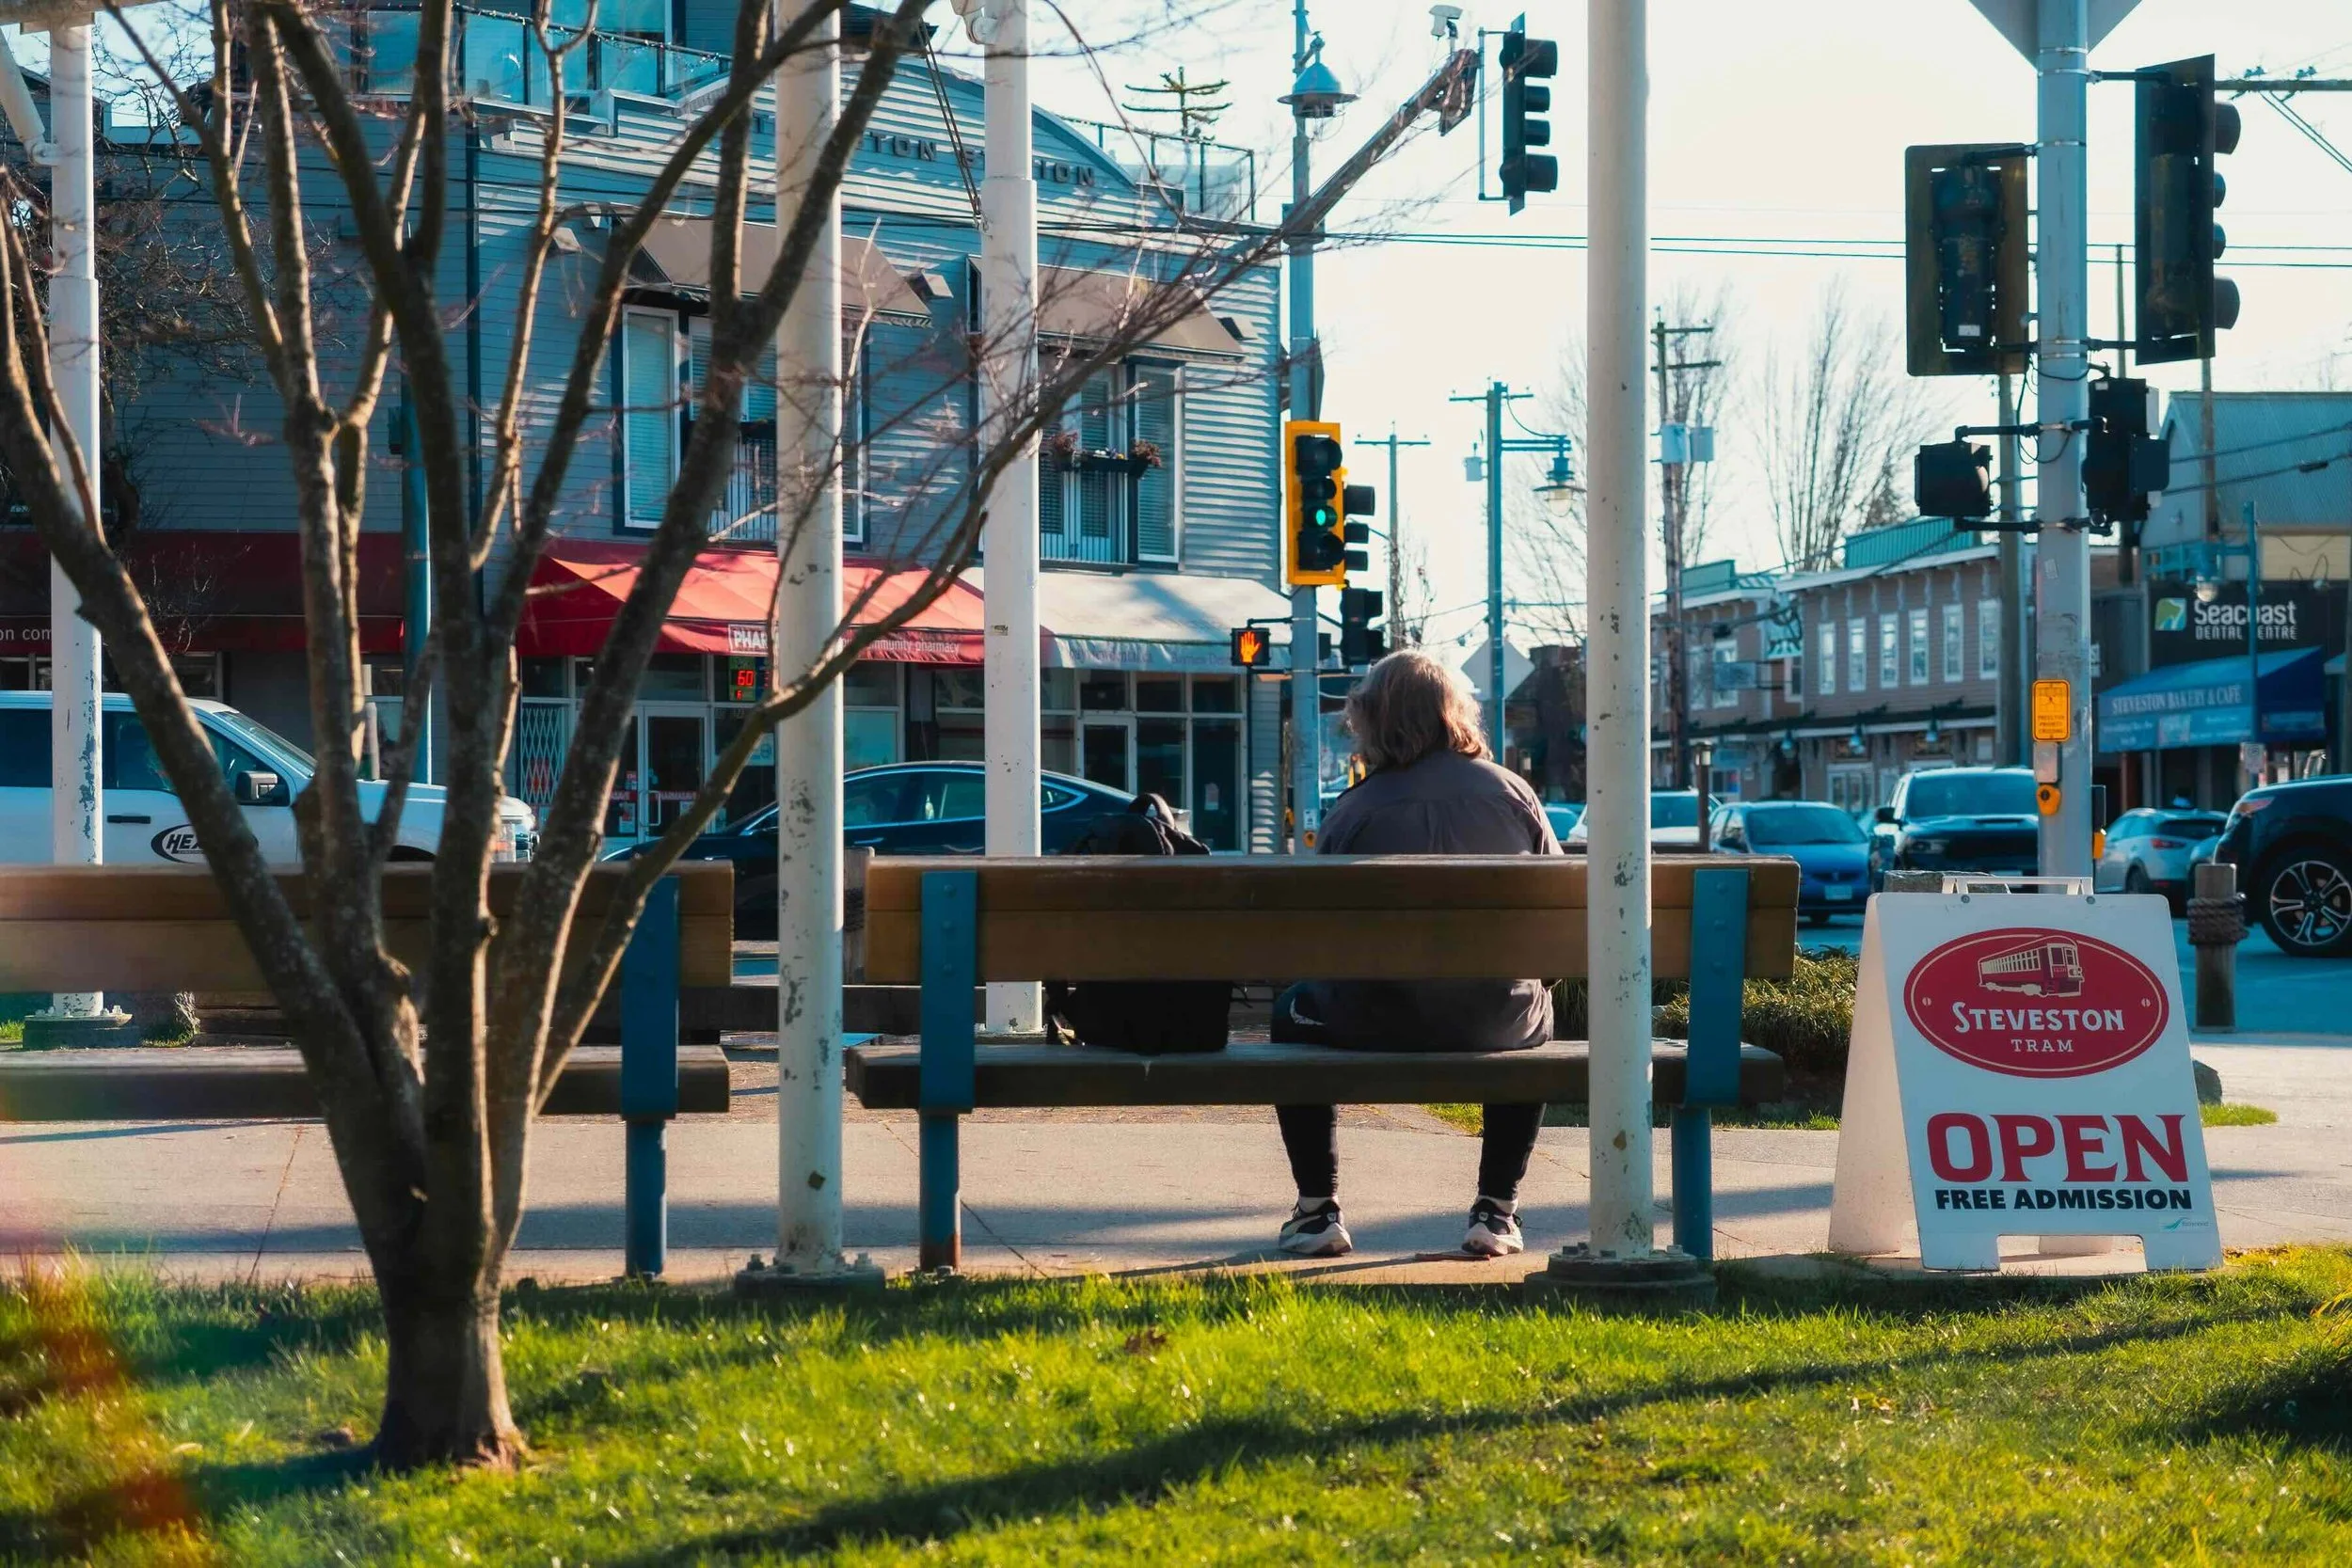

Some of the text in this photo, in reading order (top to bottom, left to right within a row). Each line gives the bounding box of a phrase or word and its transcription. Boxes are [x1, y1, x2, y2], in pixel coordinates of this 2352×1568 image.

[2195, 625, 2297, 640] DENTAL ENTRE
[867, 639, 911, 653] mmunity
[737, 670, 755, 687] 60
[1952, 1001, 2125, 1033] STEVESTON
[2010, 1038, 2074, 1053] TRAM
[1927, 1113, 2189, 1183] OPEN
[1935, 1189, 2192, 1211] FREE ADMISSION
